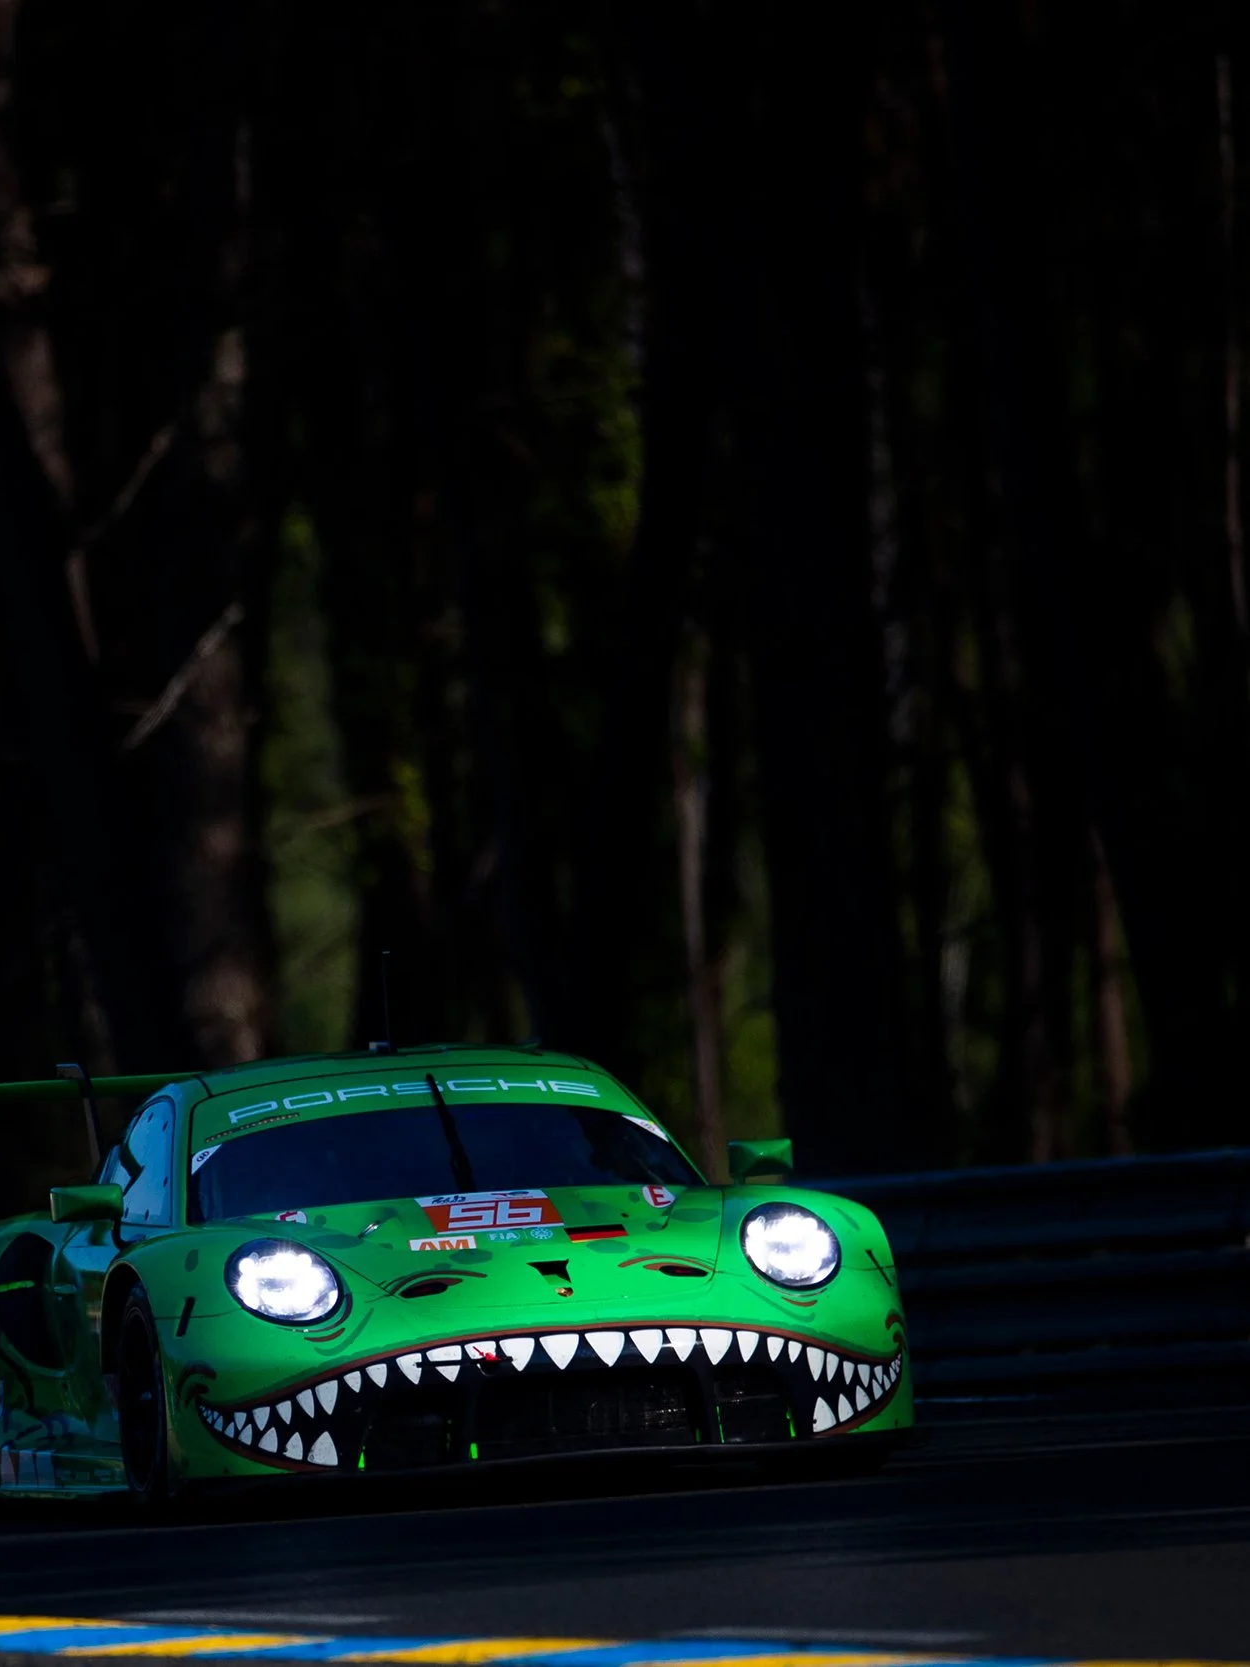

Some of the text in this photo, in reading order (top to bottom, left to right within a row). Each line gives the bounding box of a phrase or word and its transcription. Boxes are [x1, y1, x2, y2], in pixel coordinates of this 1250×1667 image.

[228, 1079, 601, 1124] PORSCHE
[648, 1185, 671, 1206] E
[448, 1201, 543, 1229] 56
[419, 1239, 470, 1251] AM
[489, 1232, 519, 1241] FIA
